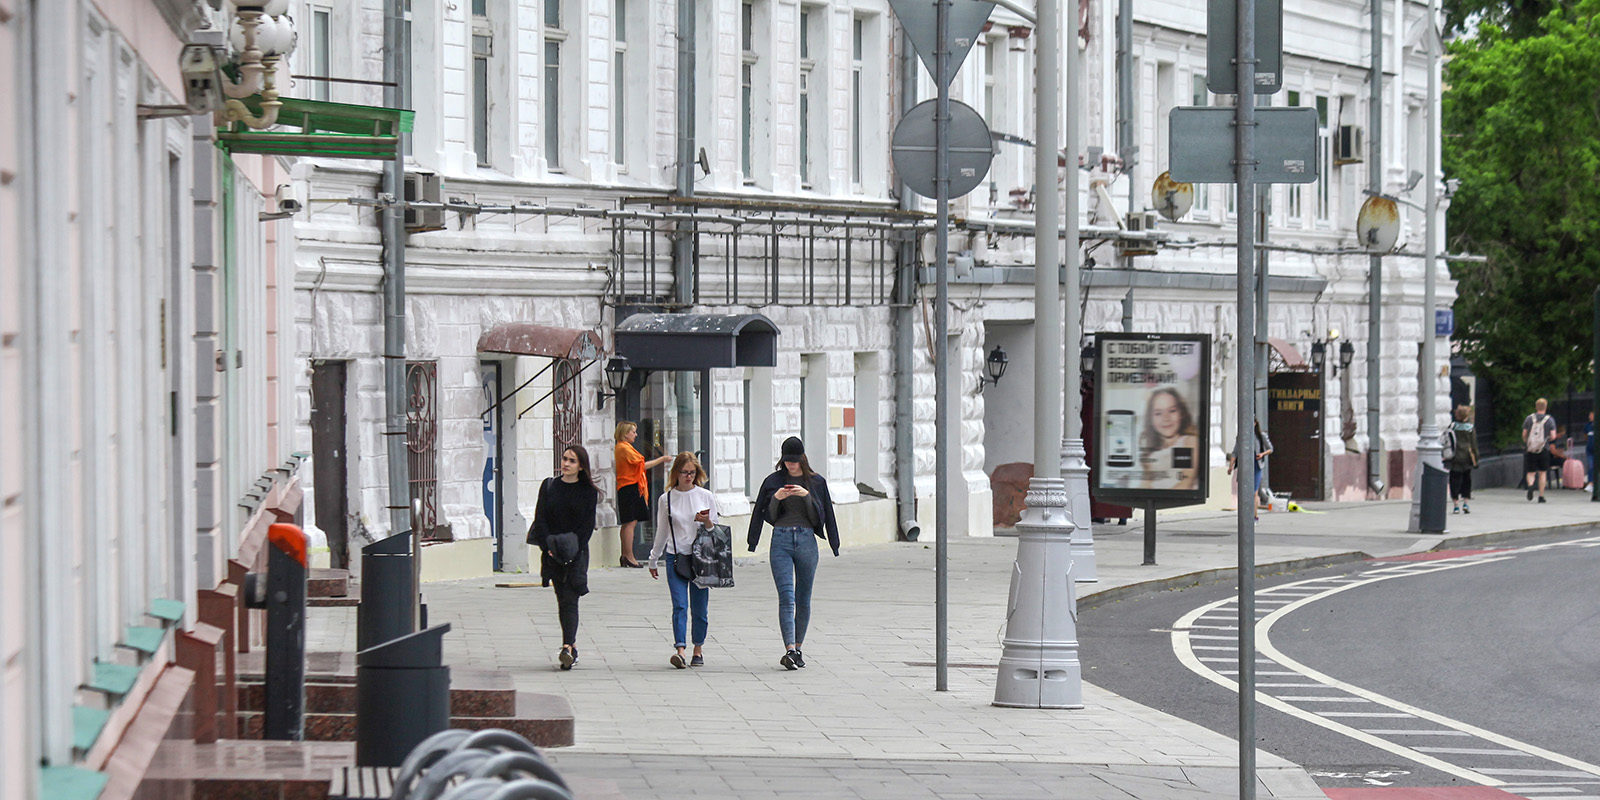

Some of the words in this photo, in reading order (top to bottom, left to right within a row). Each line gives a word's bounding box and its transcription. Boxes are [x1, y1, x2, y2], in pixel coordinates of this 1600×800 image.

[1107, 343, 1115, 354] С
[1158, 343, 1195, 355] БУДЕТ
[1277, 400, 1304, 411] КНИГИ
